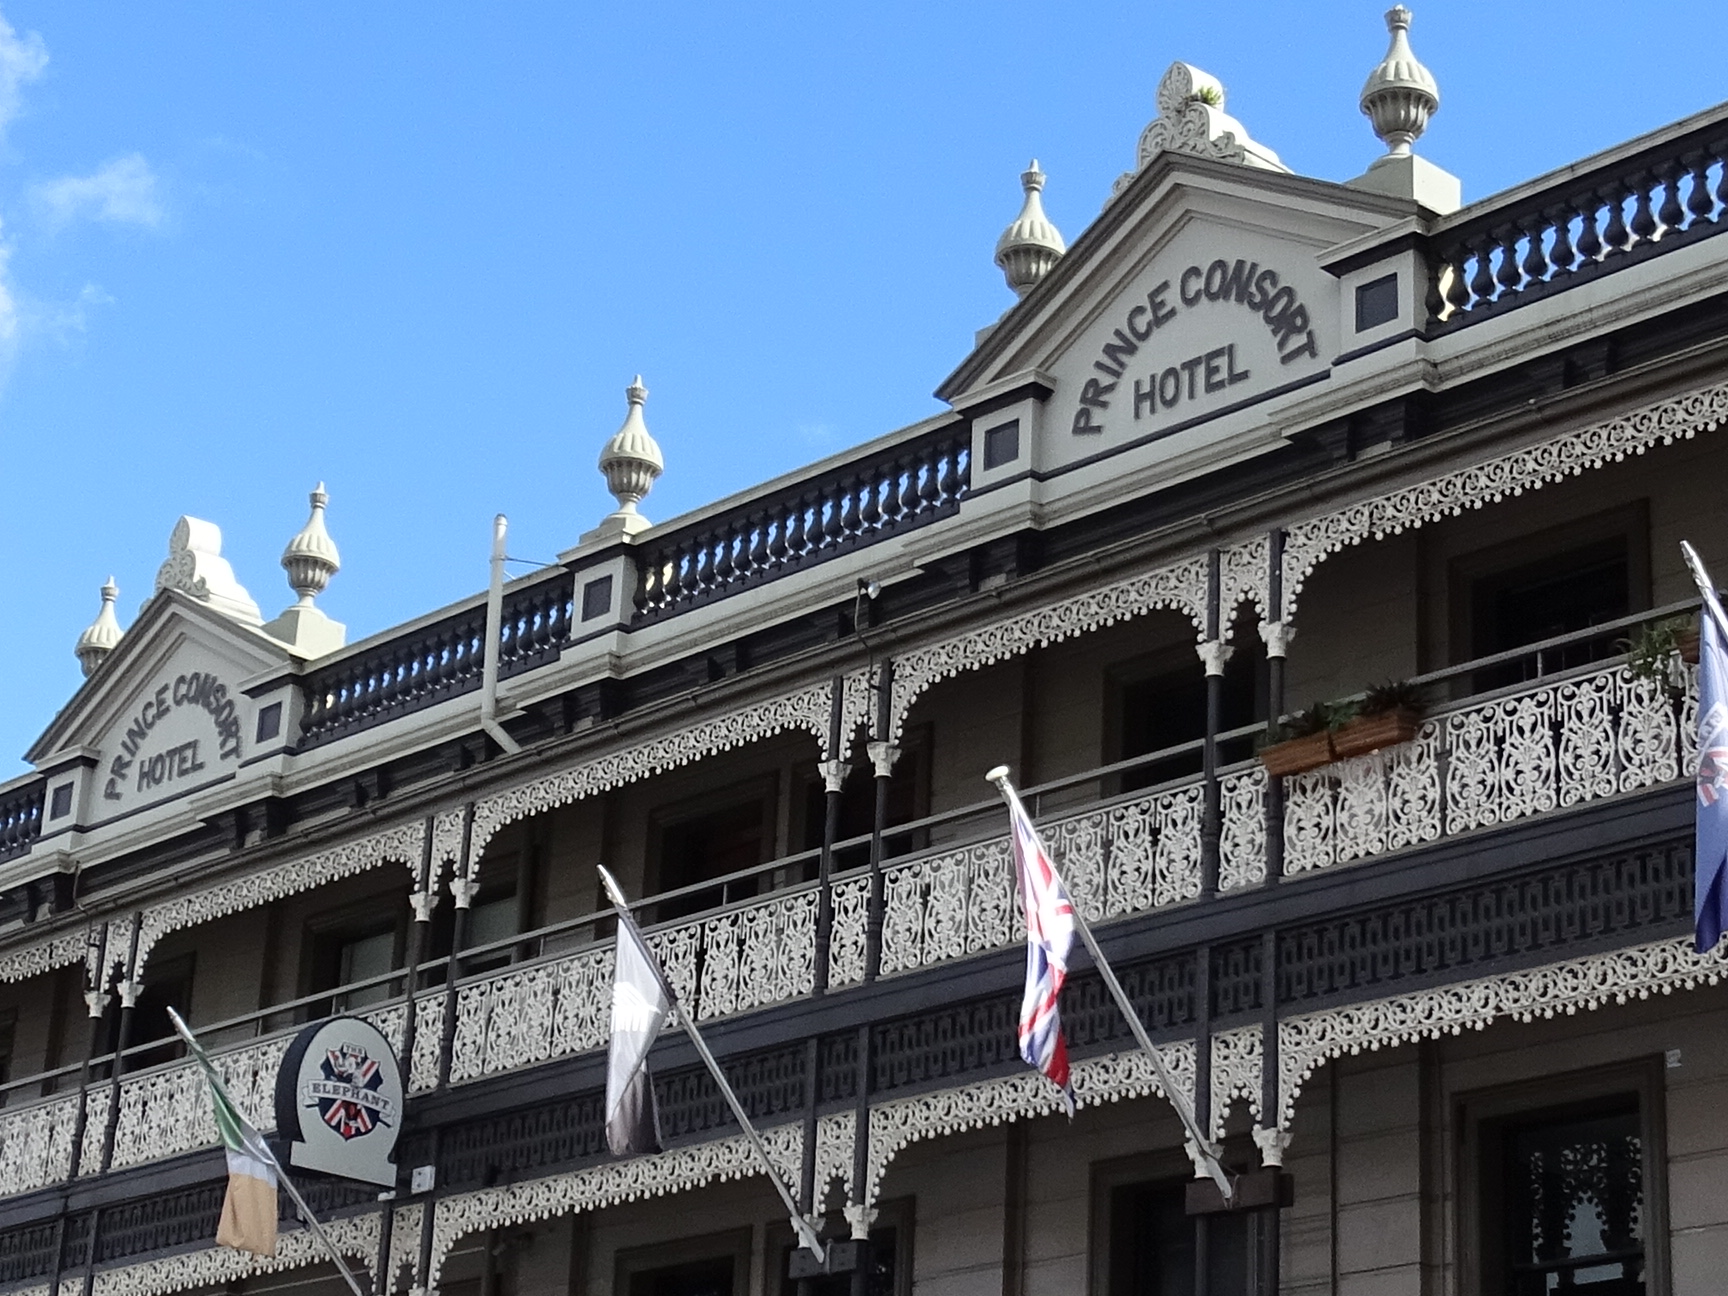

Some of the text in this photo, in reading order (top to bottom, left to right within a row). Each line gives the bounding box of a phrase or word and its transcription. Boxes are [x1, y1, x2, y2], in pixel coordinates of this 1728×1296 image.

[1071, 259, 1319, 437] PRINCE CONSORT
[1133, 343, 1250, 420] HOTEL
[104, 671, 244, 802] PRINCE CONSORT
[137, 739, 205, 792] HOTEL
[312, 1082, 390, 1112] ELEPHANT
